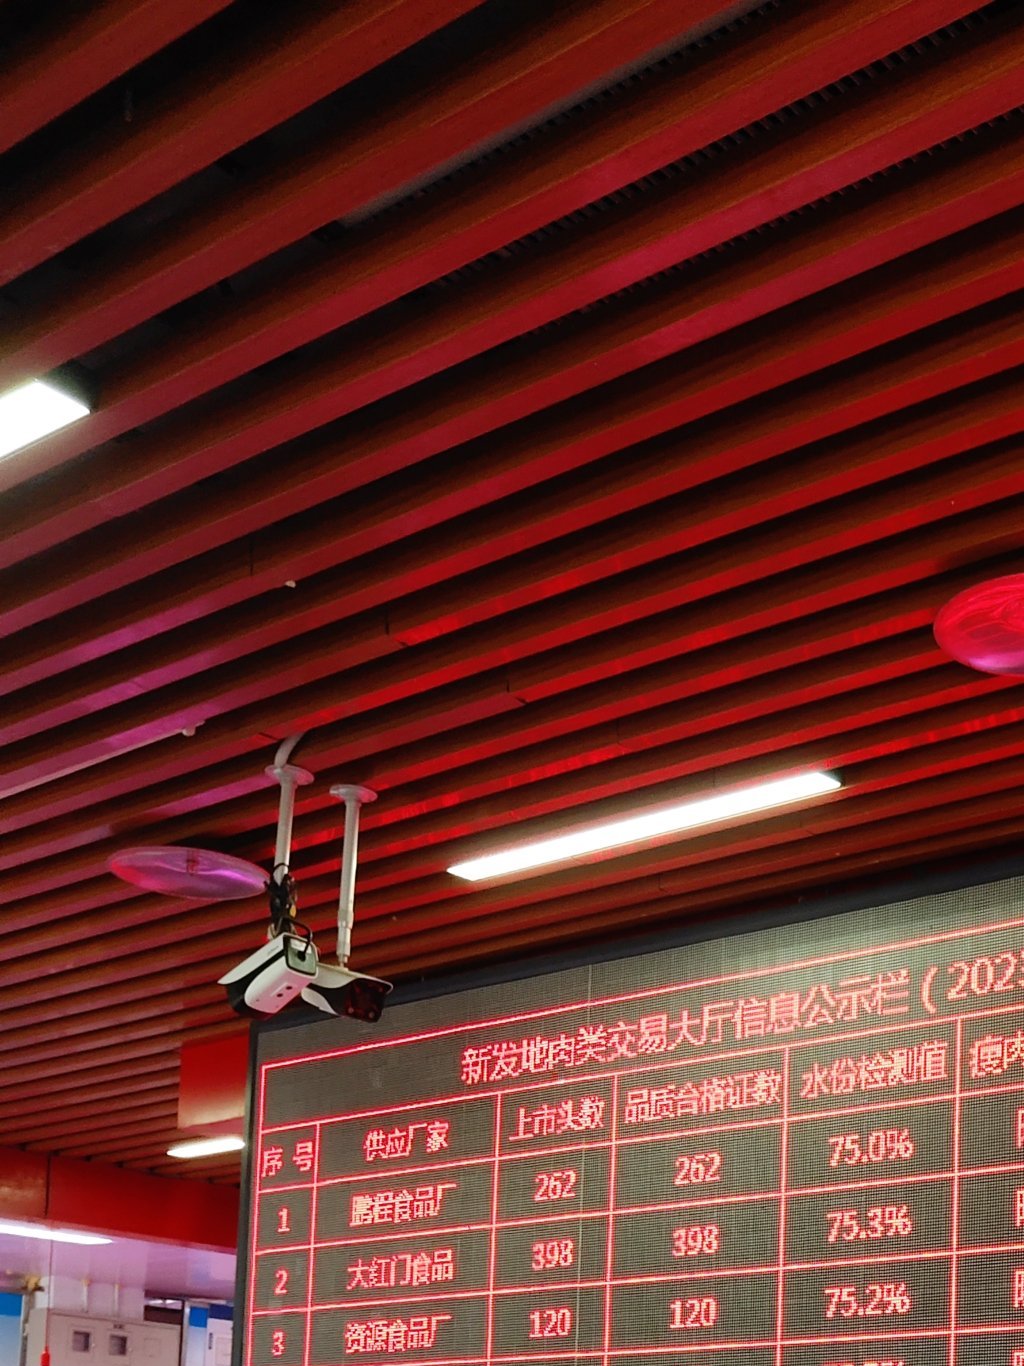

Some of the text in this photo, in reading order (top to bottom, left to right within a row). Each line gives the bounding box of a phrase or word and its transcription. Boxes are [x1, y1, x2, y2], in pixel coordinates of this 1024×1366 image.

[363, 1121, 449, 1161] 供应厂家
[509, 1098, 604, 1141] 上市头数
[625, 1071, 783, 1124] 品质合格证数
[799, 1040, 949, 1099] 水份检测值
[277, 1208, 290, 1232] 1
[350, 1183, 457, 1227] 鹏程食品厂
[534, 1170, 577, 1201] 262
[674, 1152, 721, 1185] 262
[828, 1126, 914, 1167] 75.0%
[275, 1271, 289, 1295] 2
[347, 1250, 453, 1290] 大红门食品
[532, 1239, 573, 1269] 398
[672, 1225, 719, 1257] 398
[826, 1204, 913, 1243] 75.3%
[272, 1331, 284, 1354] 3
[344, 1315, 452, 1354] 资源食品厂
[529, 1308, 571, 1339] 120
[670, 1298, 717, 1329] 120
[824, 1282, 911, 1319] 75.2%
